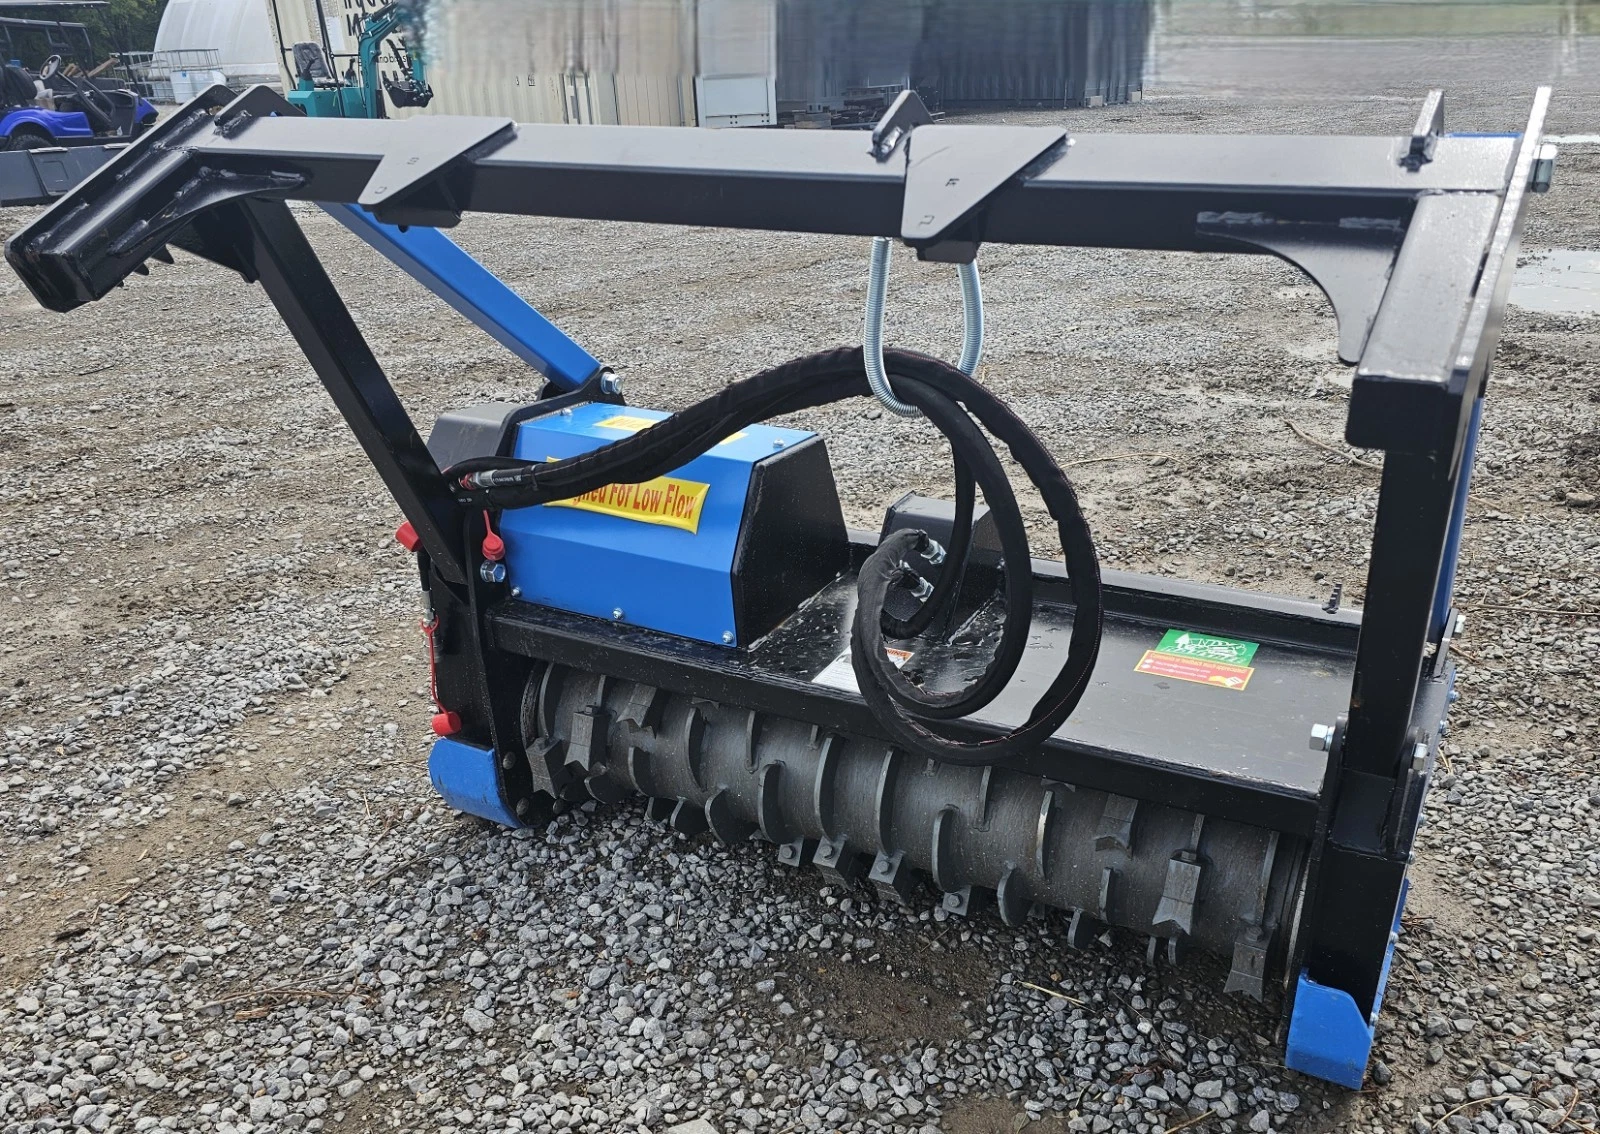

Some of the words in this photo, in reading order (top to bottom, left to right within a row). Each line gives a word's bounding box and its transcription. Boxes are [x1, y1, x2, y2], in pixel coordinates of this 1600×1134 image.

[609, 483, 633, 508] For
[633, 483, 664, 513] Low
[663, 484, 697, 520] Flow
